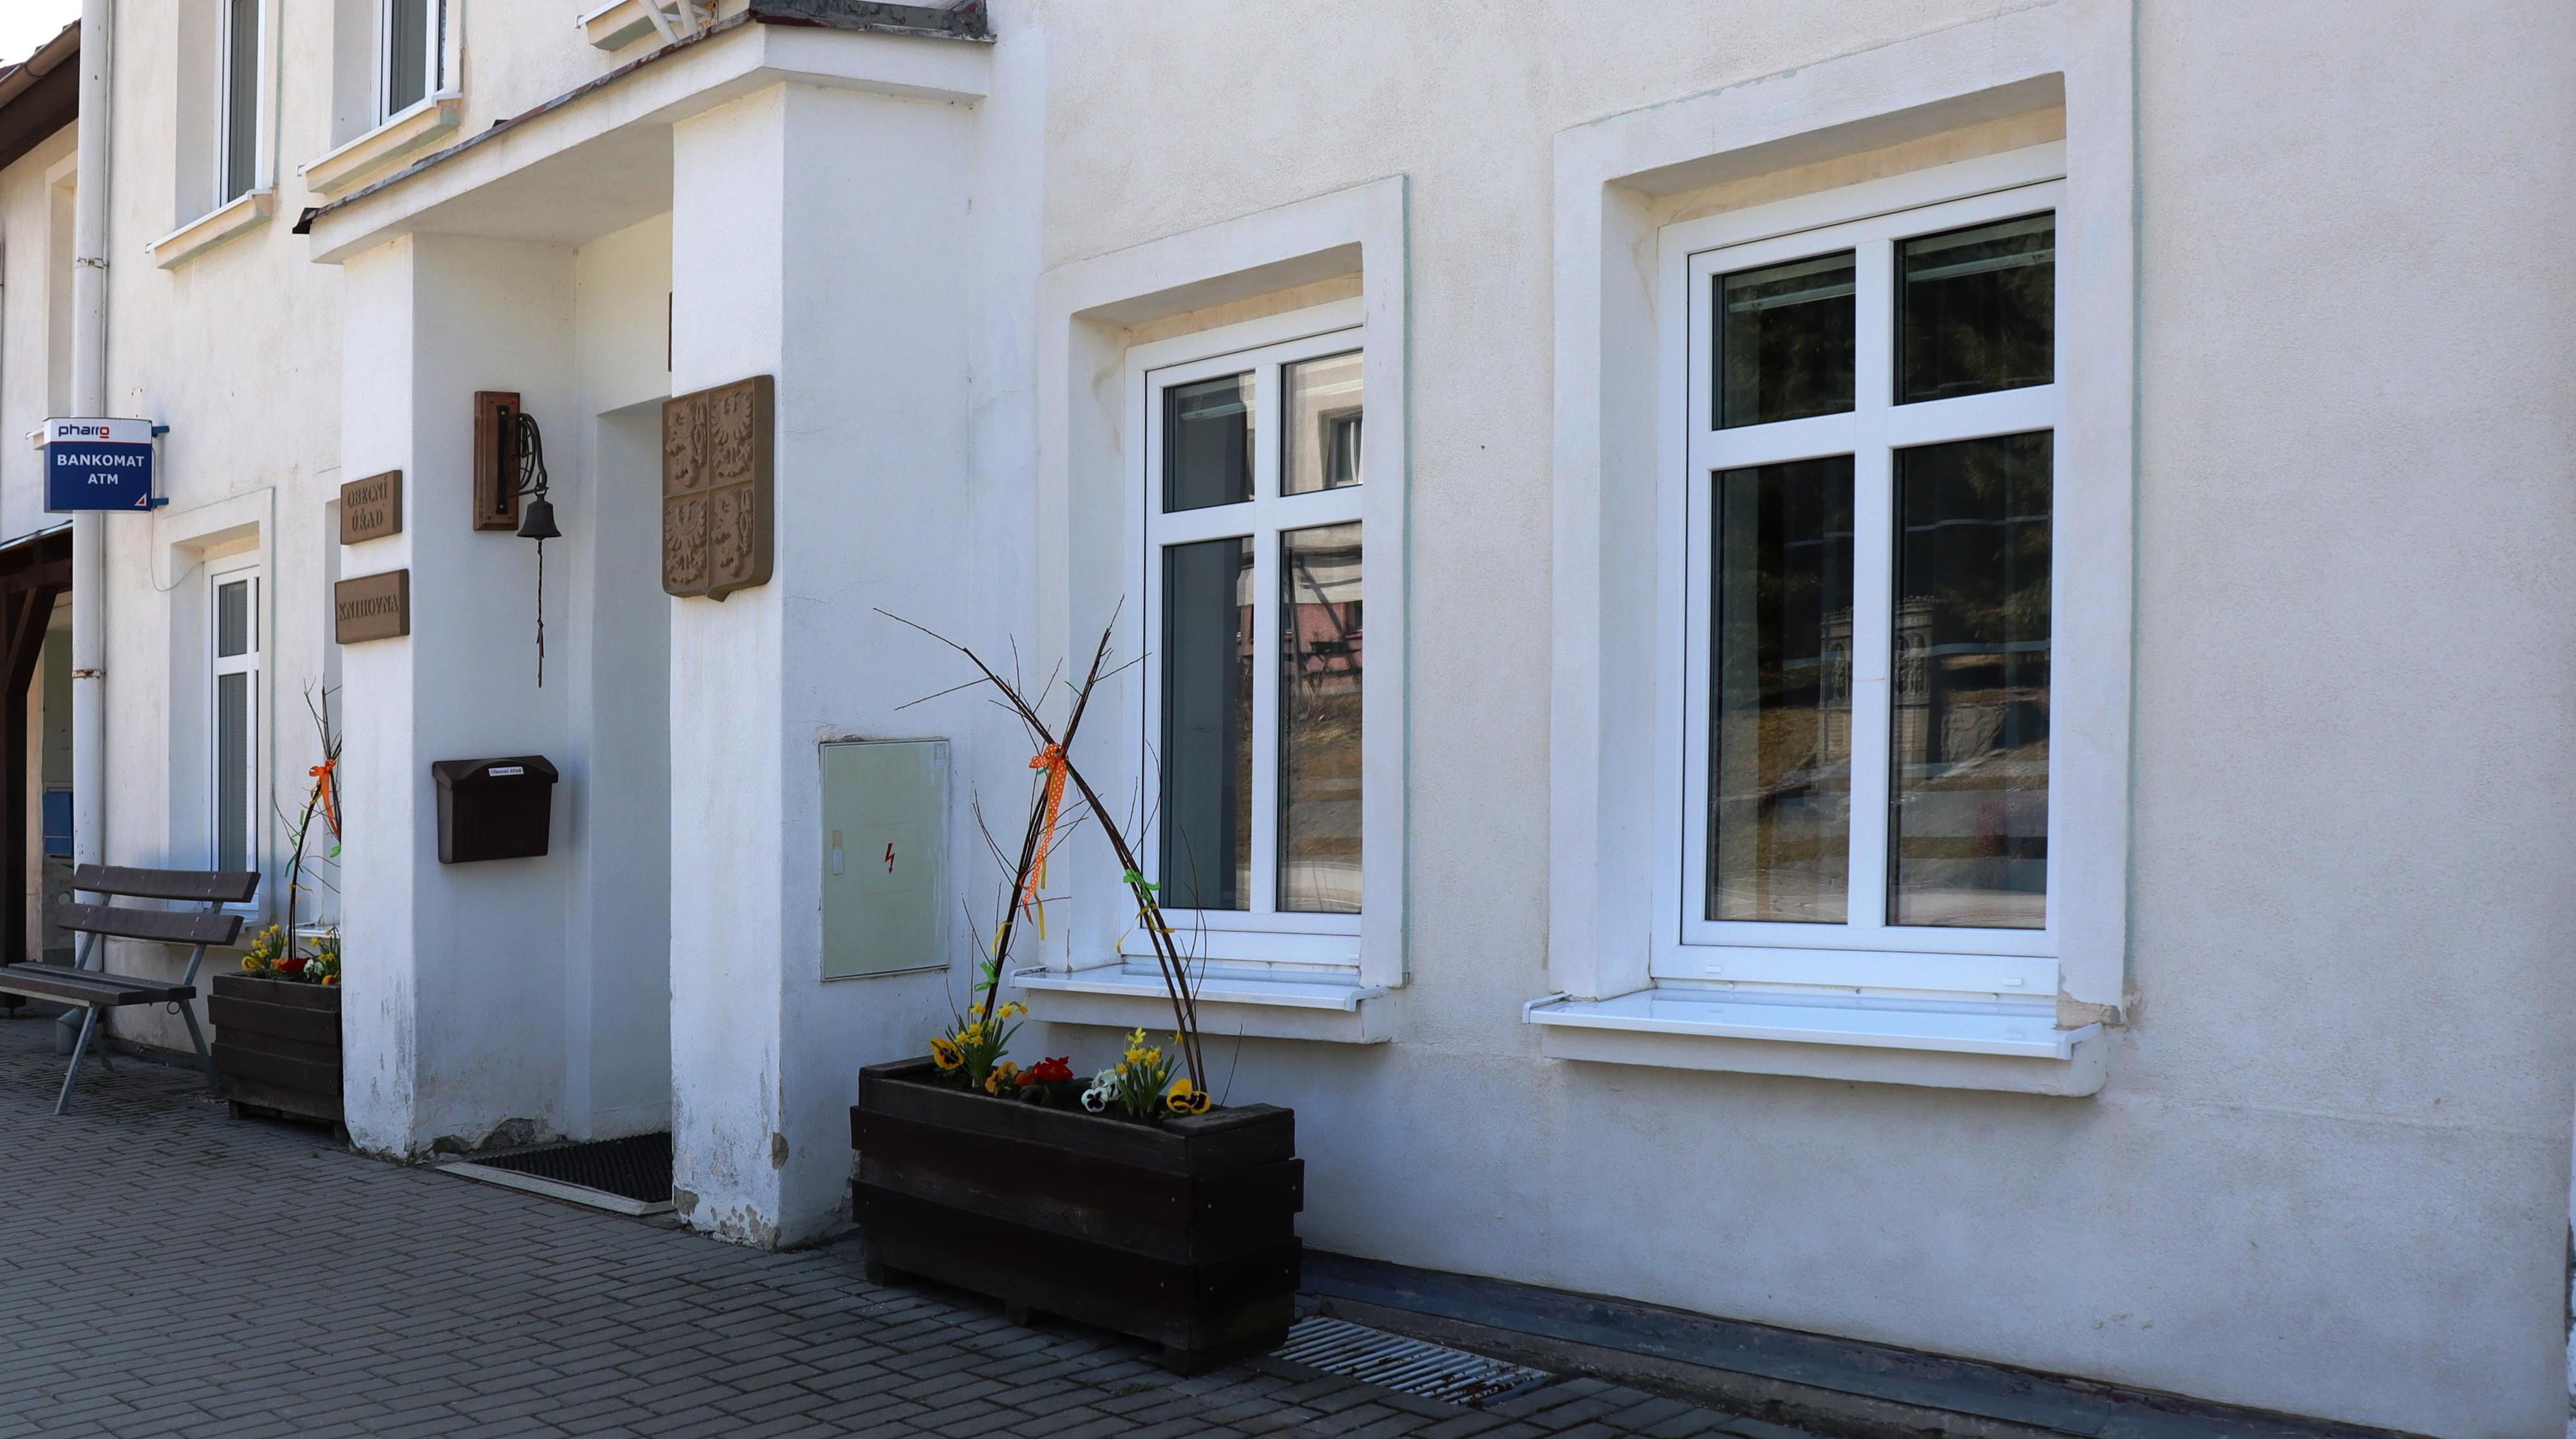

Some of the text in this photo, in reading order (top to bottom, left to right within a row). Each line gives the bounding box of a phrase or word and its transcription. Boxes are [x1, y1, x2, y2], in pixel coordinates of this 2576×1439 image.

[59, 424, 109, 439] pharro
[57, 454, 144, 467] BANKOMAT
[88, 473, 118, 484] ATM
[348, 476, 388, 508] OBECNÍ
[352, 508, 383, 532] ÚŘAD
[338, 595, 399, 620] KNIHOVNA
